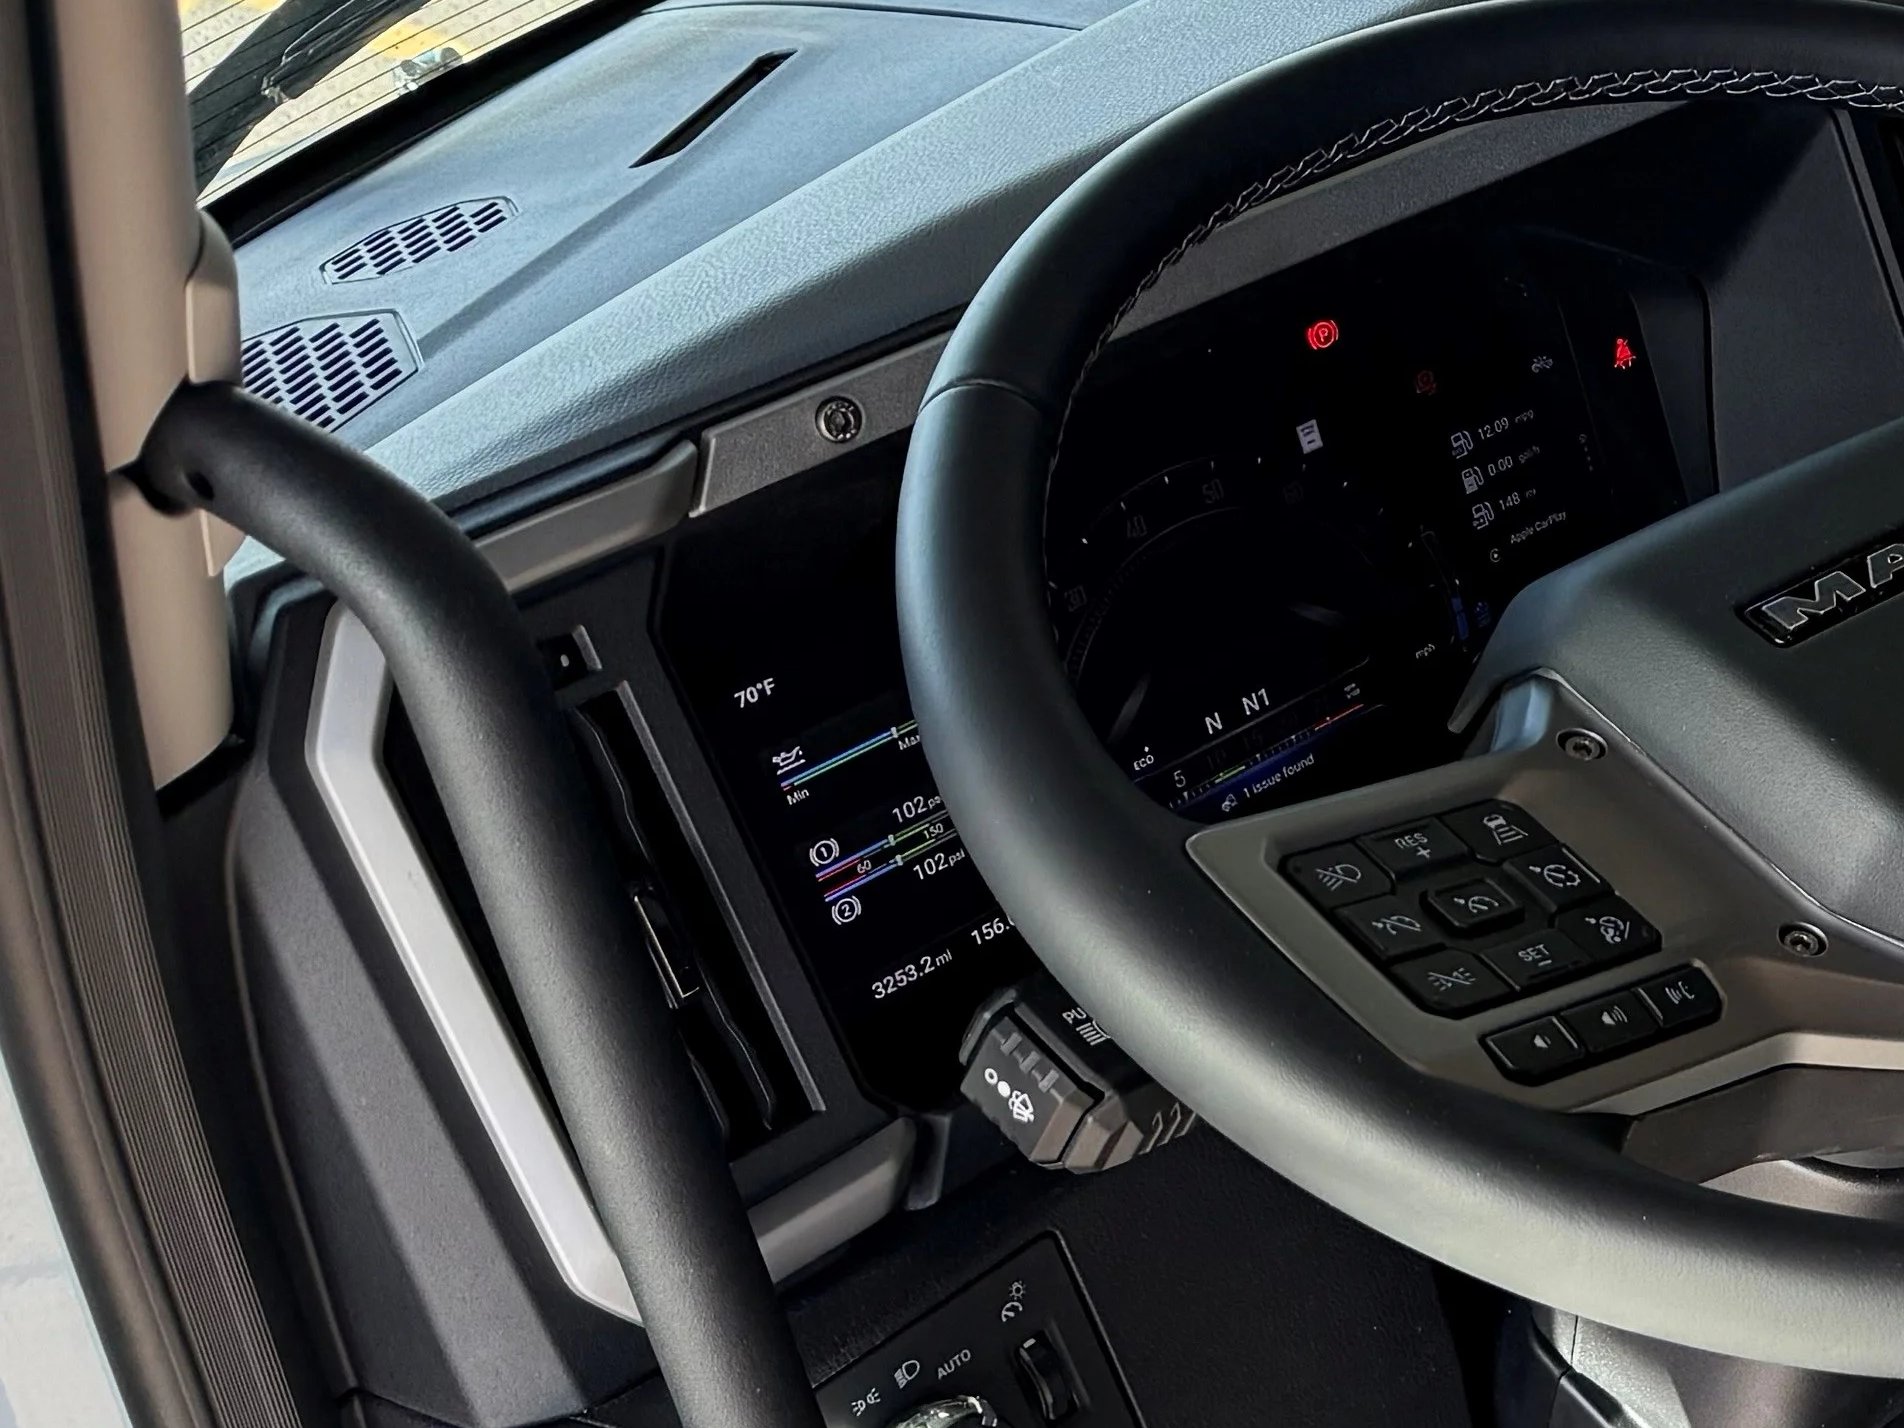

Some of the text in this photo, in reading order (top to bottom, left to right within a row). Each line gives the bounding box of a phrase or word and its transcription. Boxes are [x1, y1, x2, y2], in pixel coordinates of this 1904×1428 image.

[1477, 417, 1509, 441] 12.09
[1487, 455, 1513, 476] 0.00
[1499, 491, 1521, 511] 148
[734, 677, 776, 709] 70°F
[1204, 687, 1270, 736] N N1
[1133, 754, 1155, 772] ECO
[1172, 769, 1187, 789] 5
[1243, 753, 1315, 799] 1 issue found
[786, 787, 810, 806] Min
[892, 795, 928, 824] 102
[922, 823, 945, 840] 150
[1394, 832, 1428, 849] RES
[856, 859, 873, 875] 60
[913, 848, 966, 881] 102 psi
[1518, 944, 1550, 962] SET
[871, 955, 936, 1000] 3253.2
[1061, 1006, 1087, 1024] PU
[937, 1348, 972, 1380] AUTO
